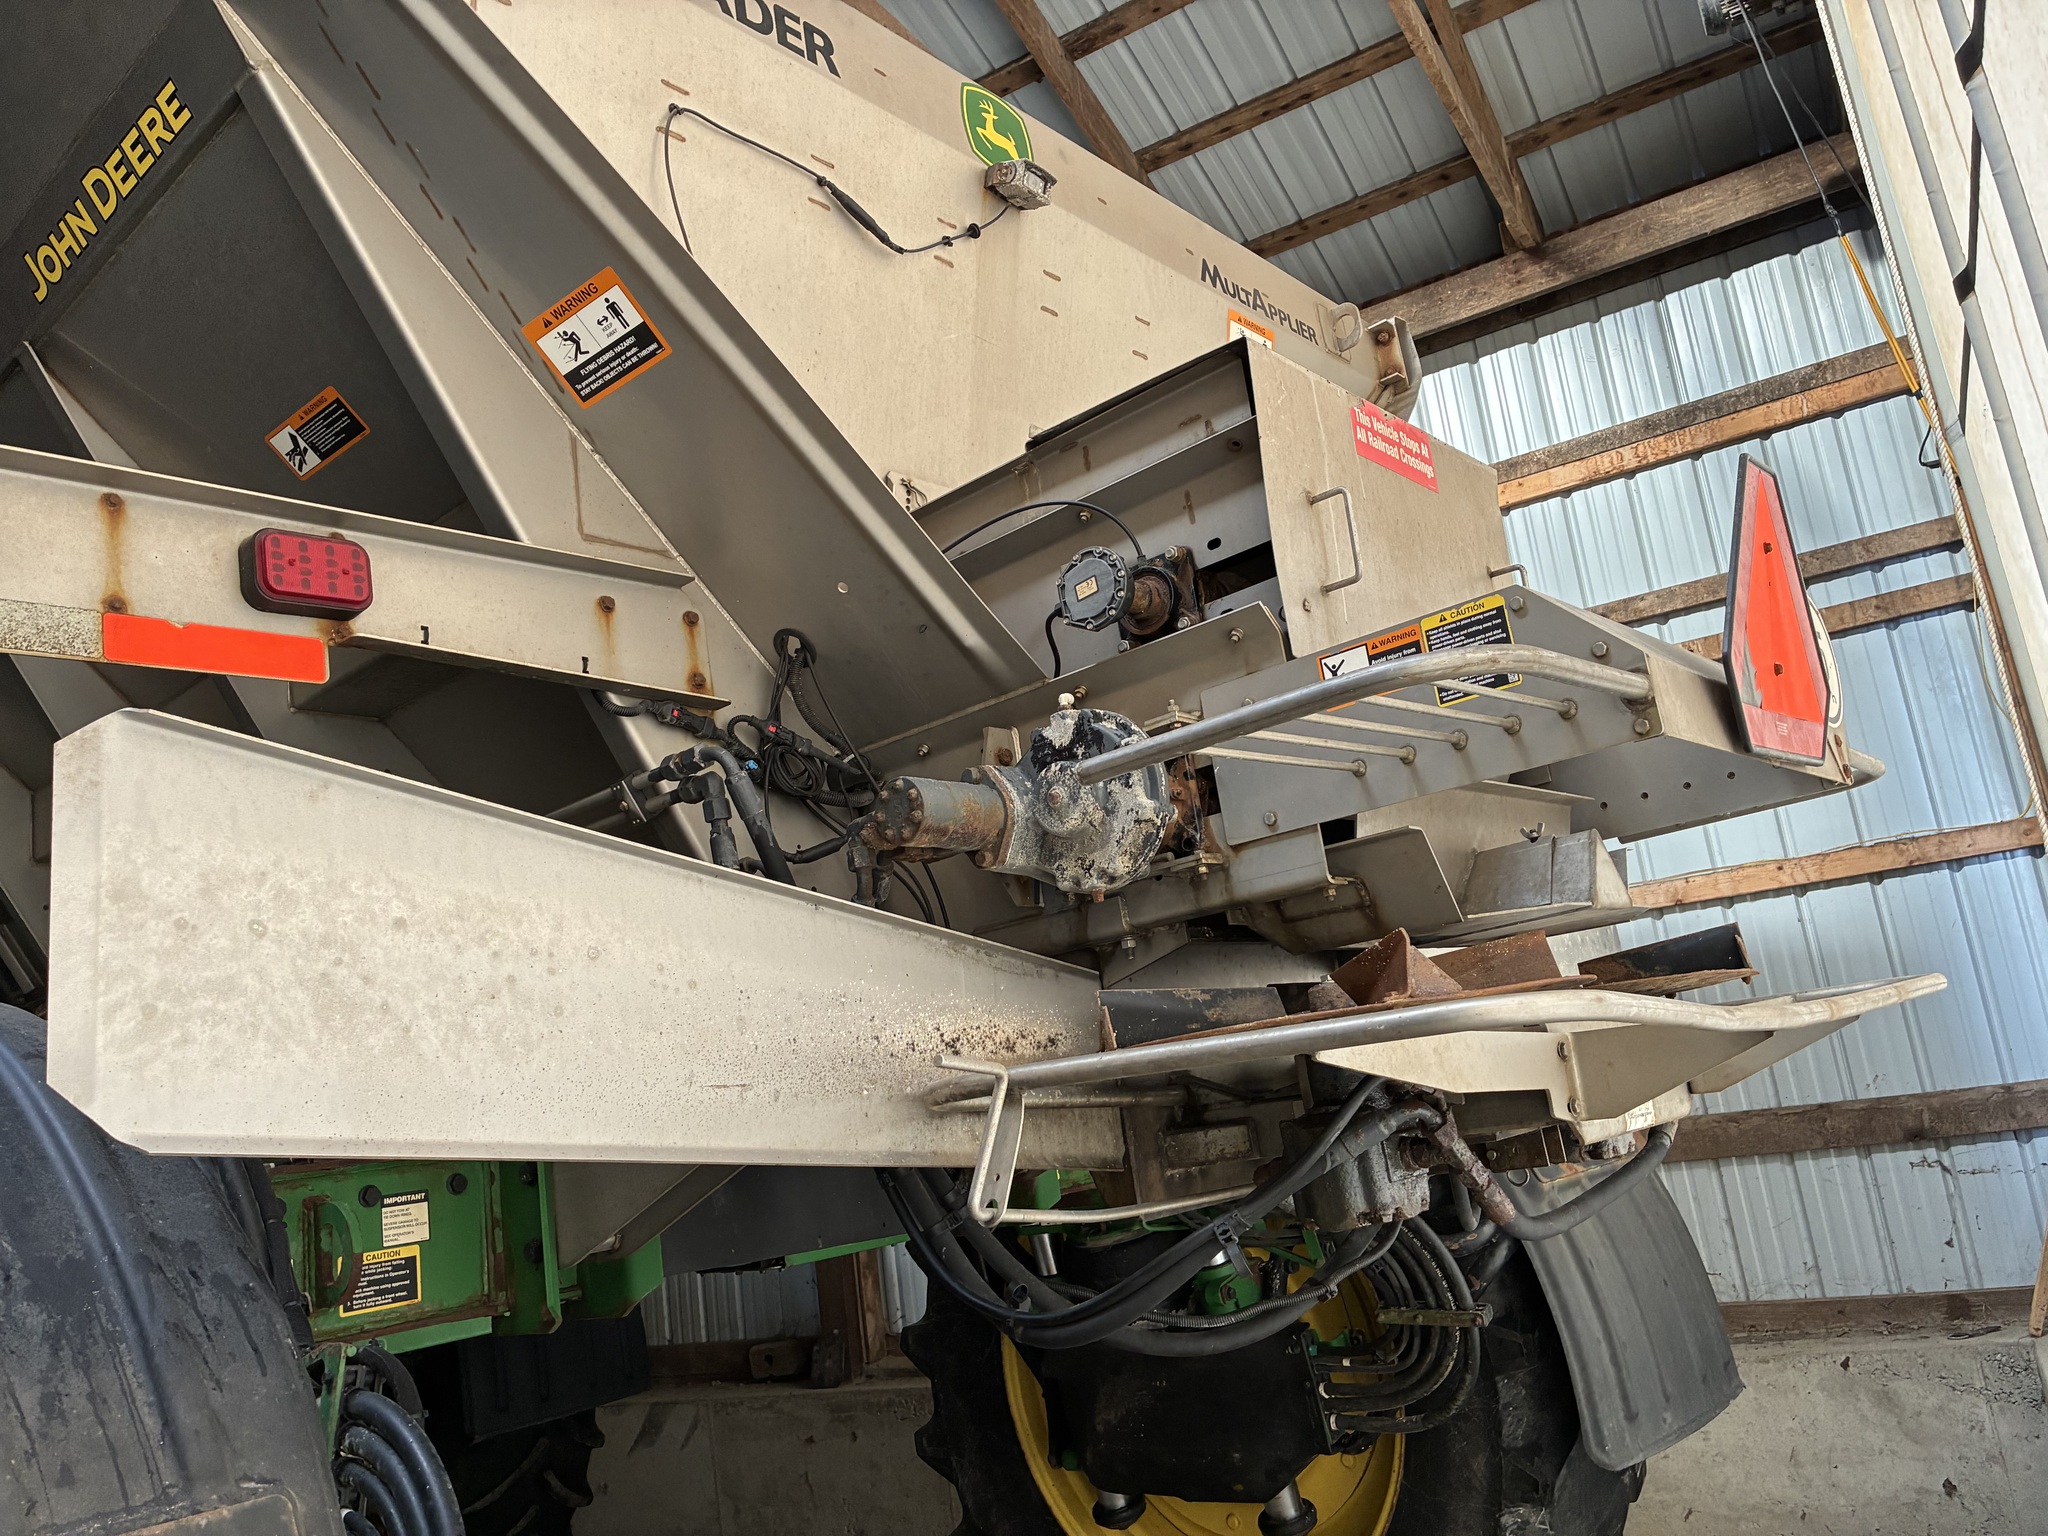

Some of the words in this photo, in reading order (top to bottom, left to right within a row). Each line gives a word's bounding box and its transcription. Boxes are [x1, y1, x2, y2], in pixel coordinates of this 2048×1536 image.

[23, 198, 99, 303] JOHN
[81, 79, 193, 221] DEERE
[550, 282, 599, 320] WARNING
[602, 322, 614, 332] KEEP
[607, 329, 618, 338] AWAY
[1242, 317, 1266, 336] WARNING
[581, 362, 598, 375] FLYING
[597, 350, 615, 364] DEBRIS
[614, 336, 636, 353] HAZARD!
[581, 387, 591, 396] STAY
[604, 366, 623, 381] OBJECTS
[623, 360, 632, 368] CAN
[639, 342, 658, 358] THROWN!
[582, 374, 597, 387] prevent
[596, 365, 610, 377] serious
[610, 358, 622, 368] injury
[302, 395, 328, 416] WARNING
[1354, 407, 1371, 428] This
[1371, 416, 1399, 442] Vehicle
[1400, 431, 1420, 454] Stops
[1421, 443, 1429, 459] At
[1357, 426, 1367, 443] All
[1368, 431, 1399, 460] Railroad
[1400, 448, 1434, 479] Crossings
[1450, 602, 1485, 618] CAUTION
[1443, 623, 1456, 631] shields
[1468, 625, 1483, 633] clothing
[1378, 629, 1417, 647] WARNING
[1489, 633, 1506, 641] servicing
[1372, 657, 1386, 666] Avoid
[1387, 652, 1401, 662] injury
[1402, 647, 1416, 655] from
[384, 1193, 425, 1205] IMPORTANT
[365, 1250, 400, 1261] CAUTION
